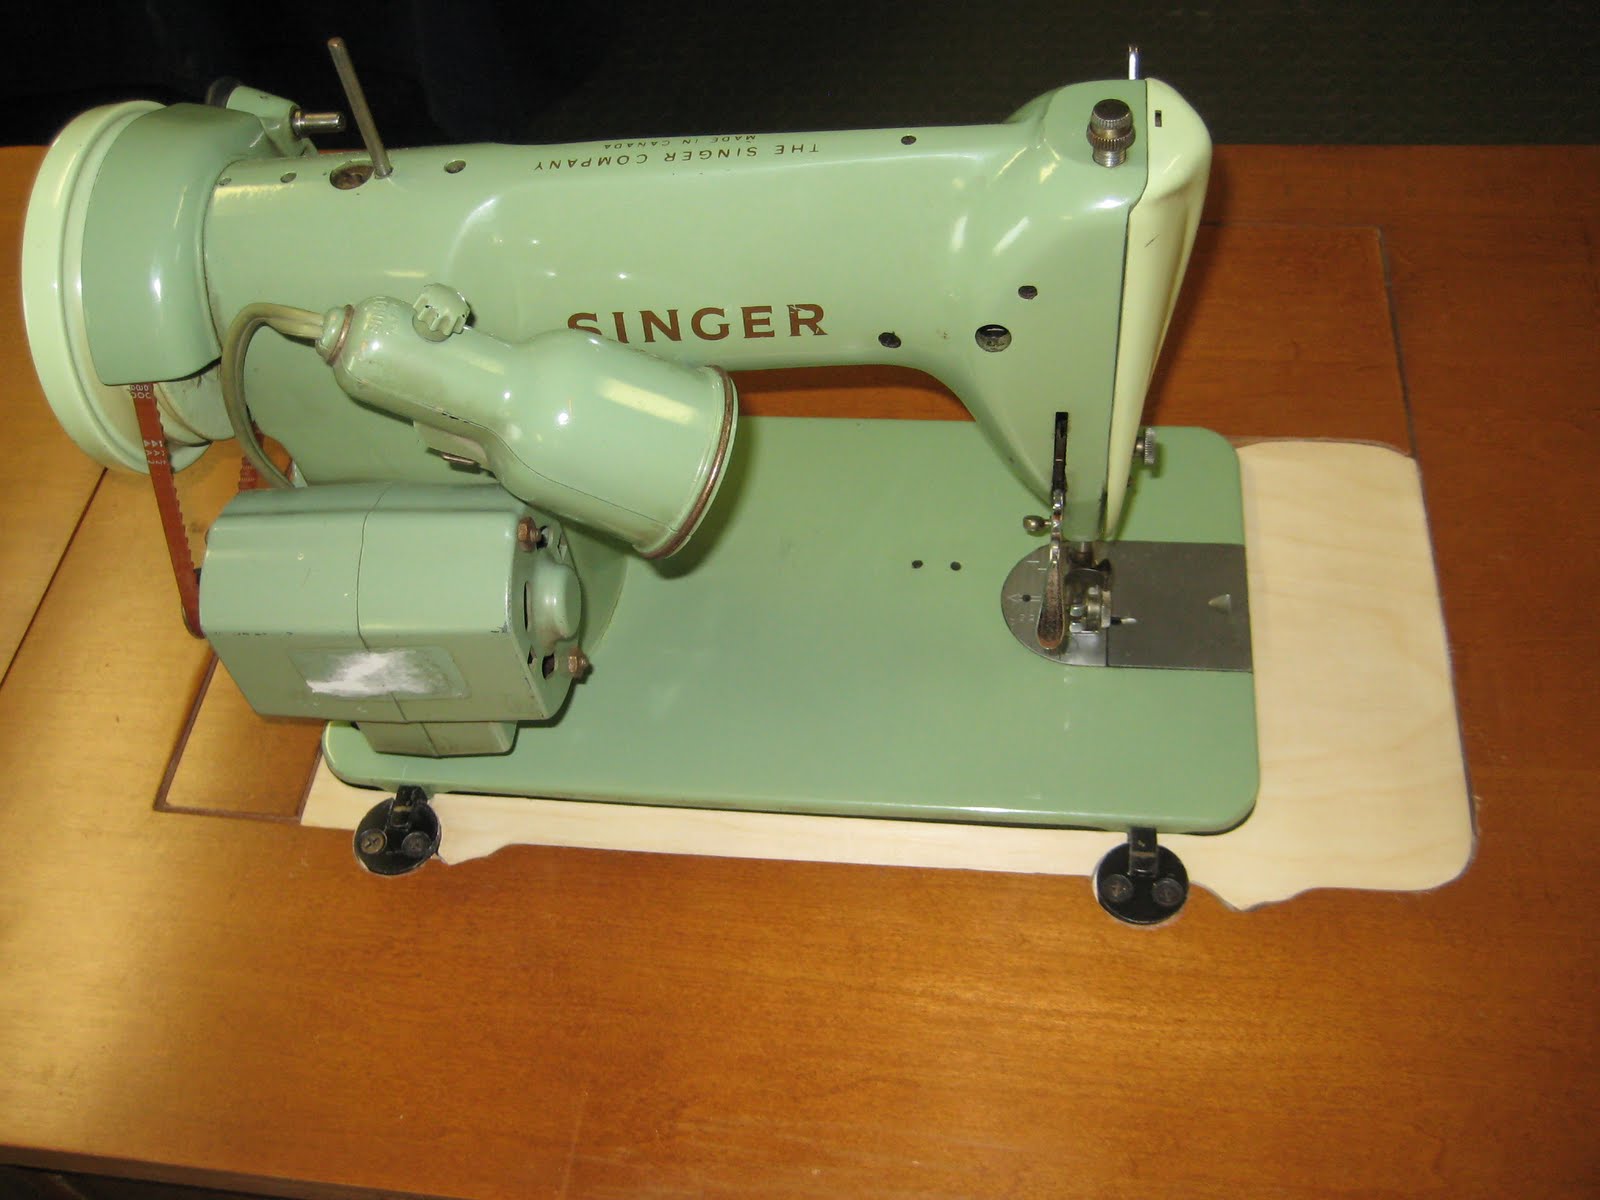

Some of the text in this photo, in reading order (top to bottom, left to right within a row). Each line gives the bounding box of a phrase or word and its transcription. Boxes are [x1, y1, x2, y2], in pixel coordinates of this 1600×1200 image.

[604, 140, 670, 150] CANADA
[709, 134, 756, 143] MADE
[534, 143, 819, 171] THE SINGER COMPANY
[567, 303, 828, 344] SINGER
